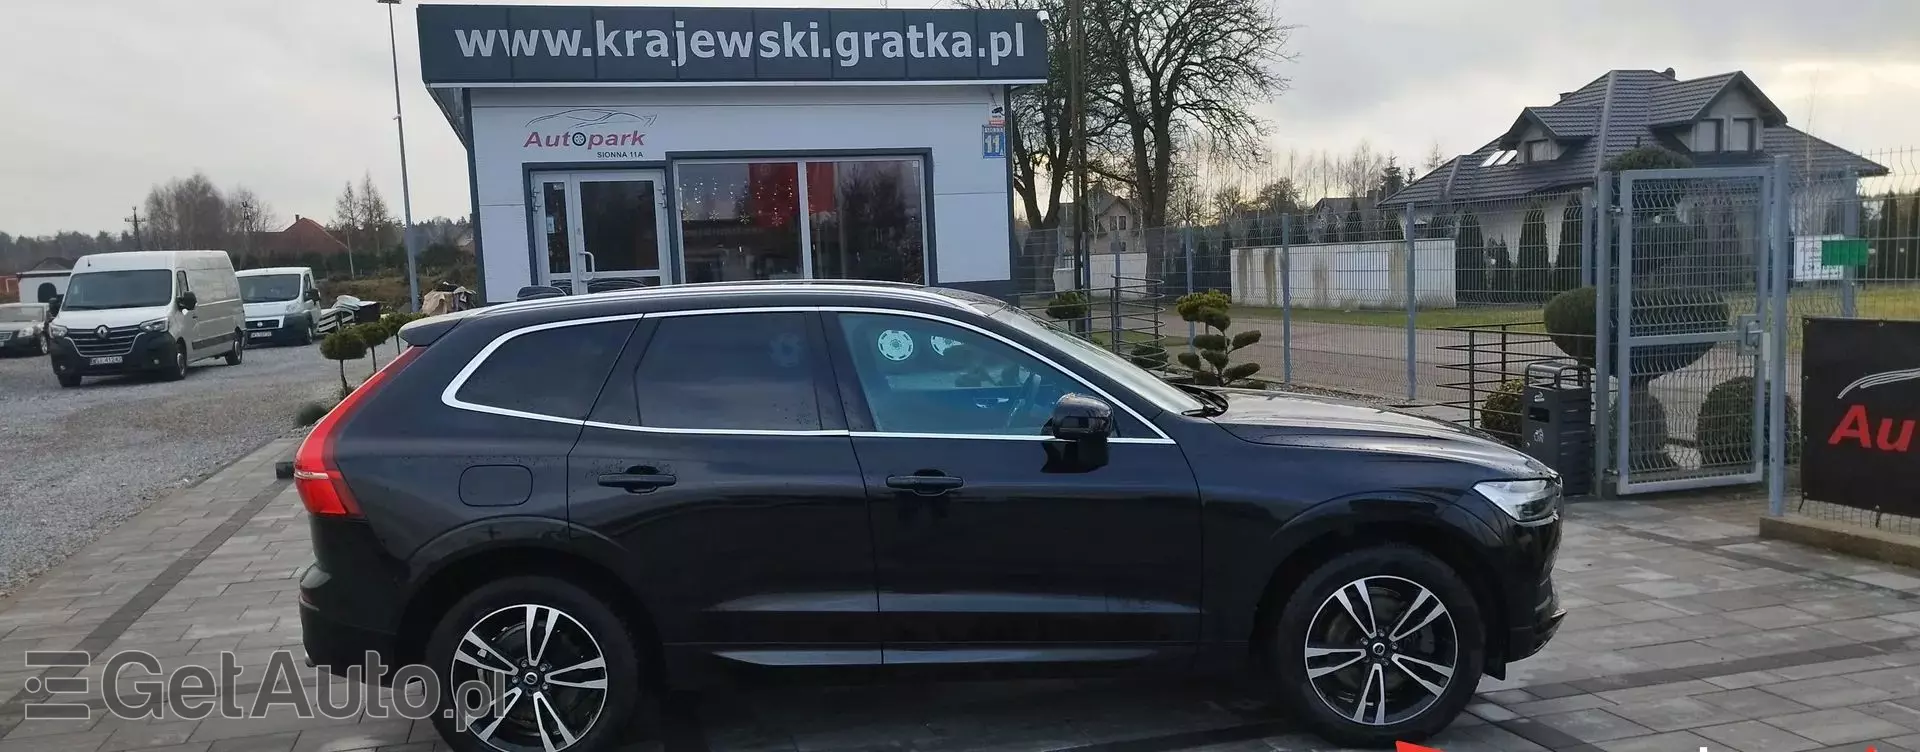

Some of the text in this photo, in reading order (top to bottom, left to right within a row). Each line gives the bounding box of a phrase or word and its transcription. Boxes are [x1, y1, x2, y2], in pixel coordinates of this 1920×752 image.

[454, 20, 1024, 66] www.krajewski.gratka.pl
[523, 130, 646, 150] Autopark
[1828, 404, 1916, 452] Au
